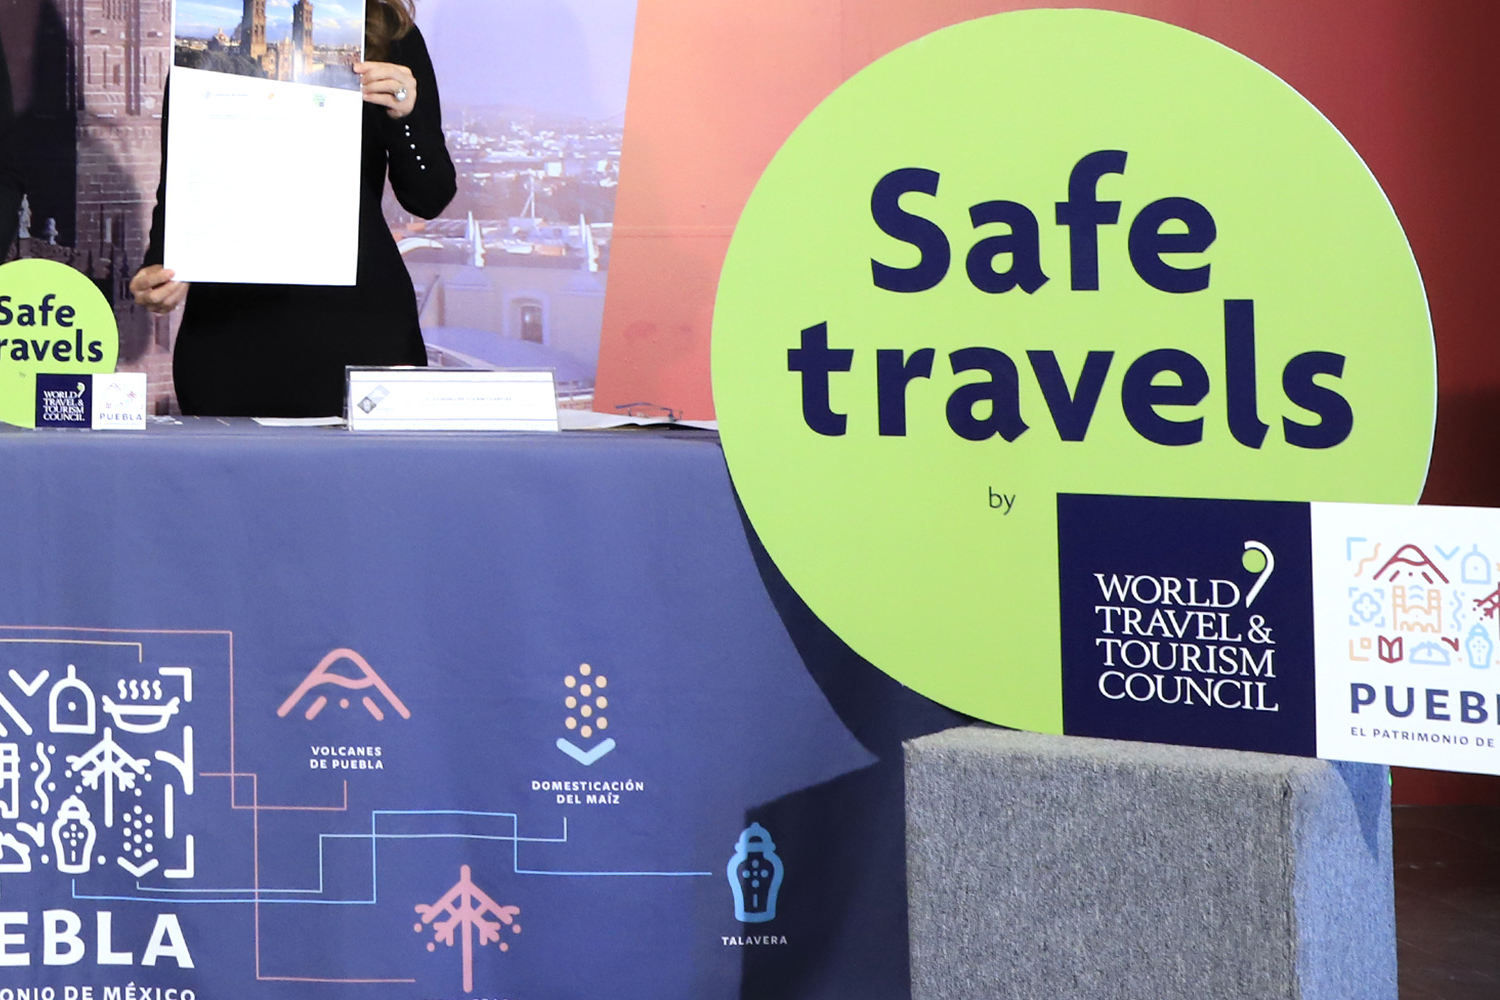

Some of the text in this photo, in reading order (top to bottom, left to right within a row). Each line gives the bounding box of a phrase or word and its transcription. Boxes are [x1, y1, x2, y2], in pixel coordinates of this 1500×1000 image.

[870, 149, 1218, 294] Safe
[787, 298, 1354, 450] travels
[989, 486, 1015, 515] by
[1094, 573, 1240, 609] WORLD
[1095, 605, 1275, 644] TRAVEL &
[1096, 637, 1277, 678] TOURISM
[1098, 671, 1279, 712] COUNCIL
[1350, 682, 1500, 725] PUEB
[310, 745, 382, 757] VOLCANES
[1350, 726, 1495, 748] EL PATRIMONIO DE
[309, 758, 384, 770] DE PUEBLA
[530, 777, 645, 793] DOMESTICACIÓN
[556, 791, 620, 805] DEL MAÍZ
[720, 935, 788, 946] TALAVERA
